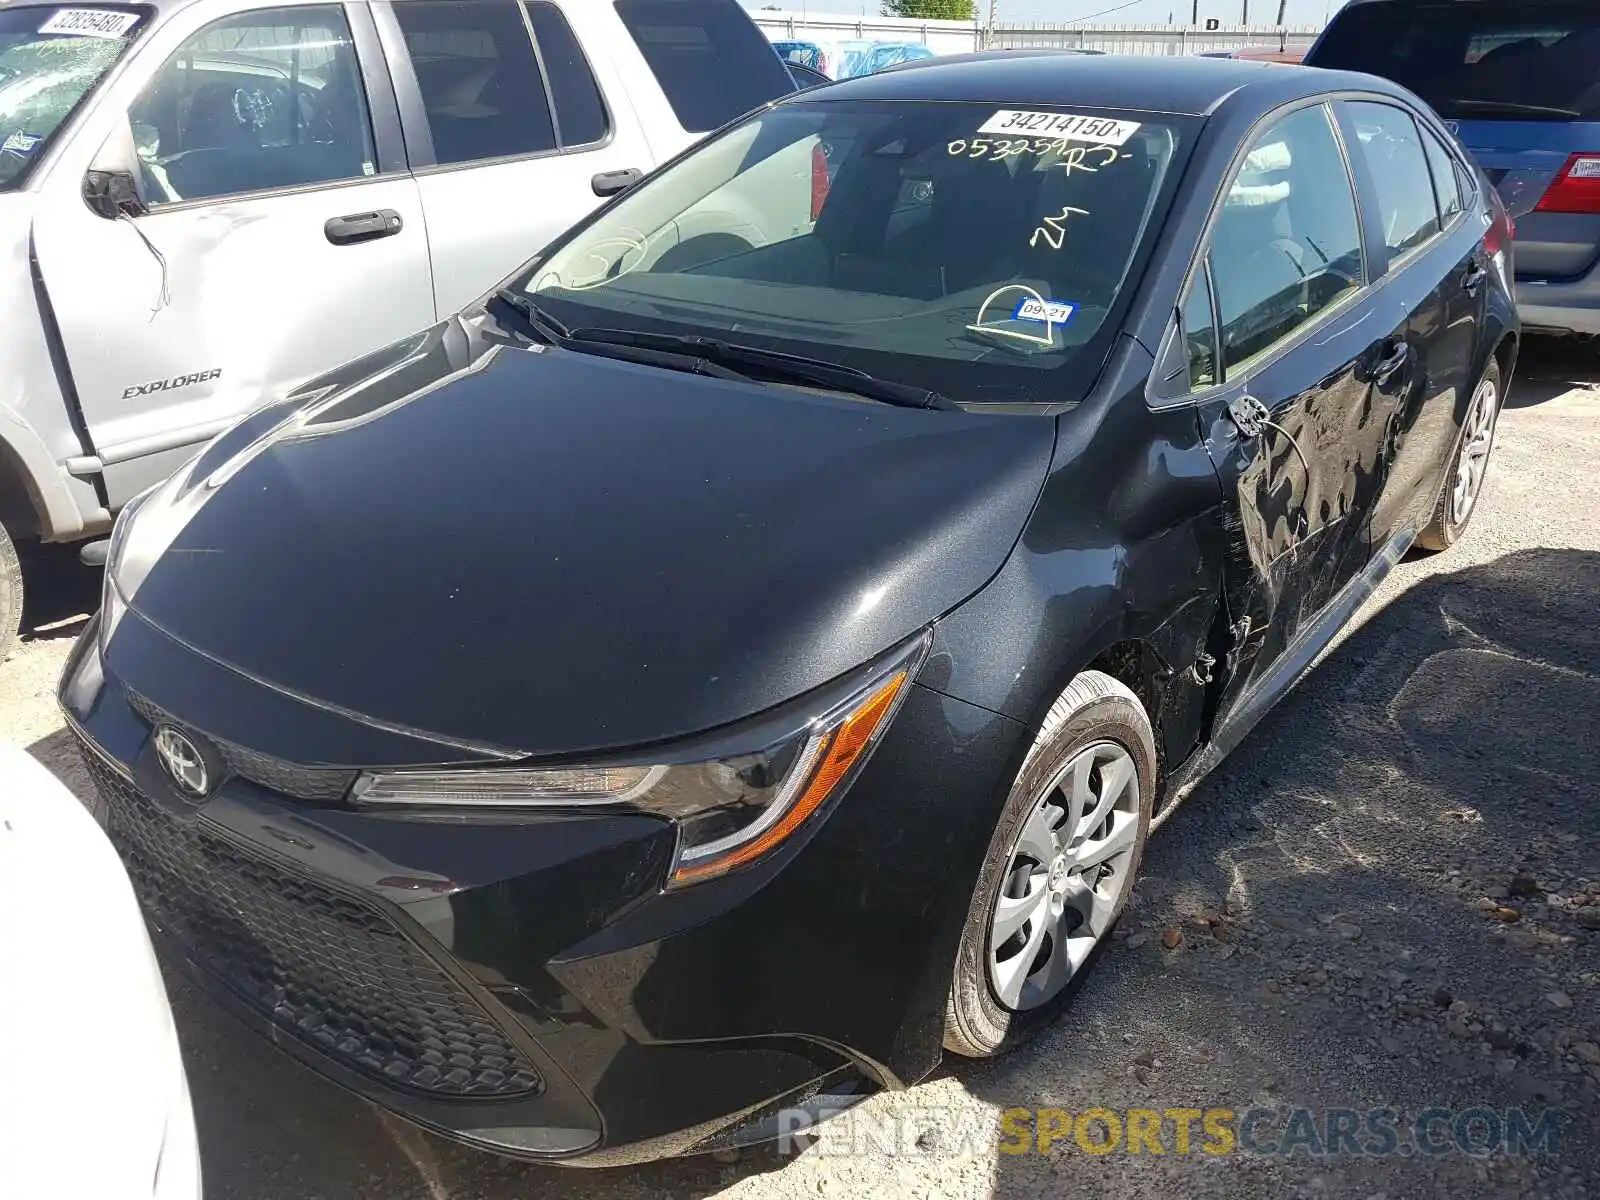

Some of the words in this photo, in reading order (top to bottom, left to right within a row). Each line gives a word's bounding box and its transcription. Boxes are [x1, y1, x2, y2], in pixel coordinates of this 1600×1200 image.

[1206, 18, 1219, 30] D
[948, 138, 1068, 161] 053259
[122, 368, 222, 399] EXPLORER
